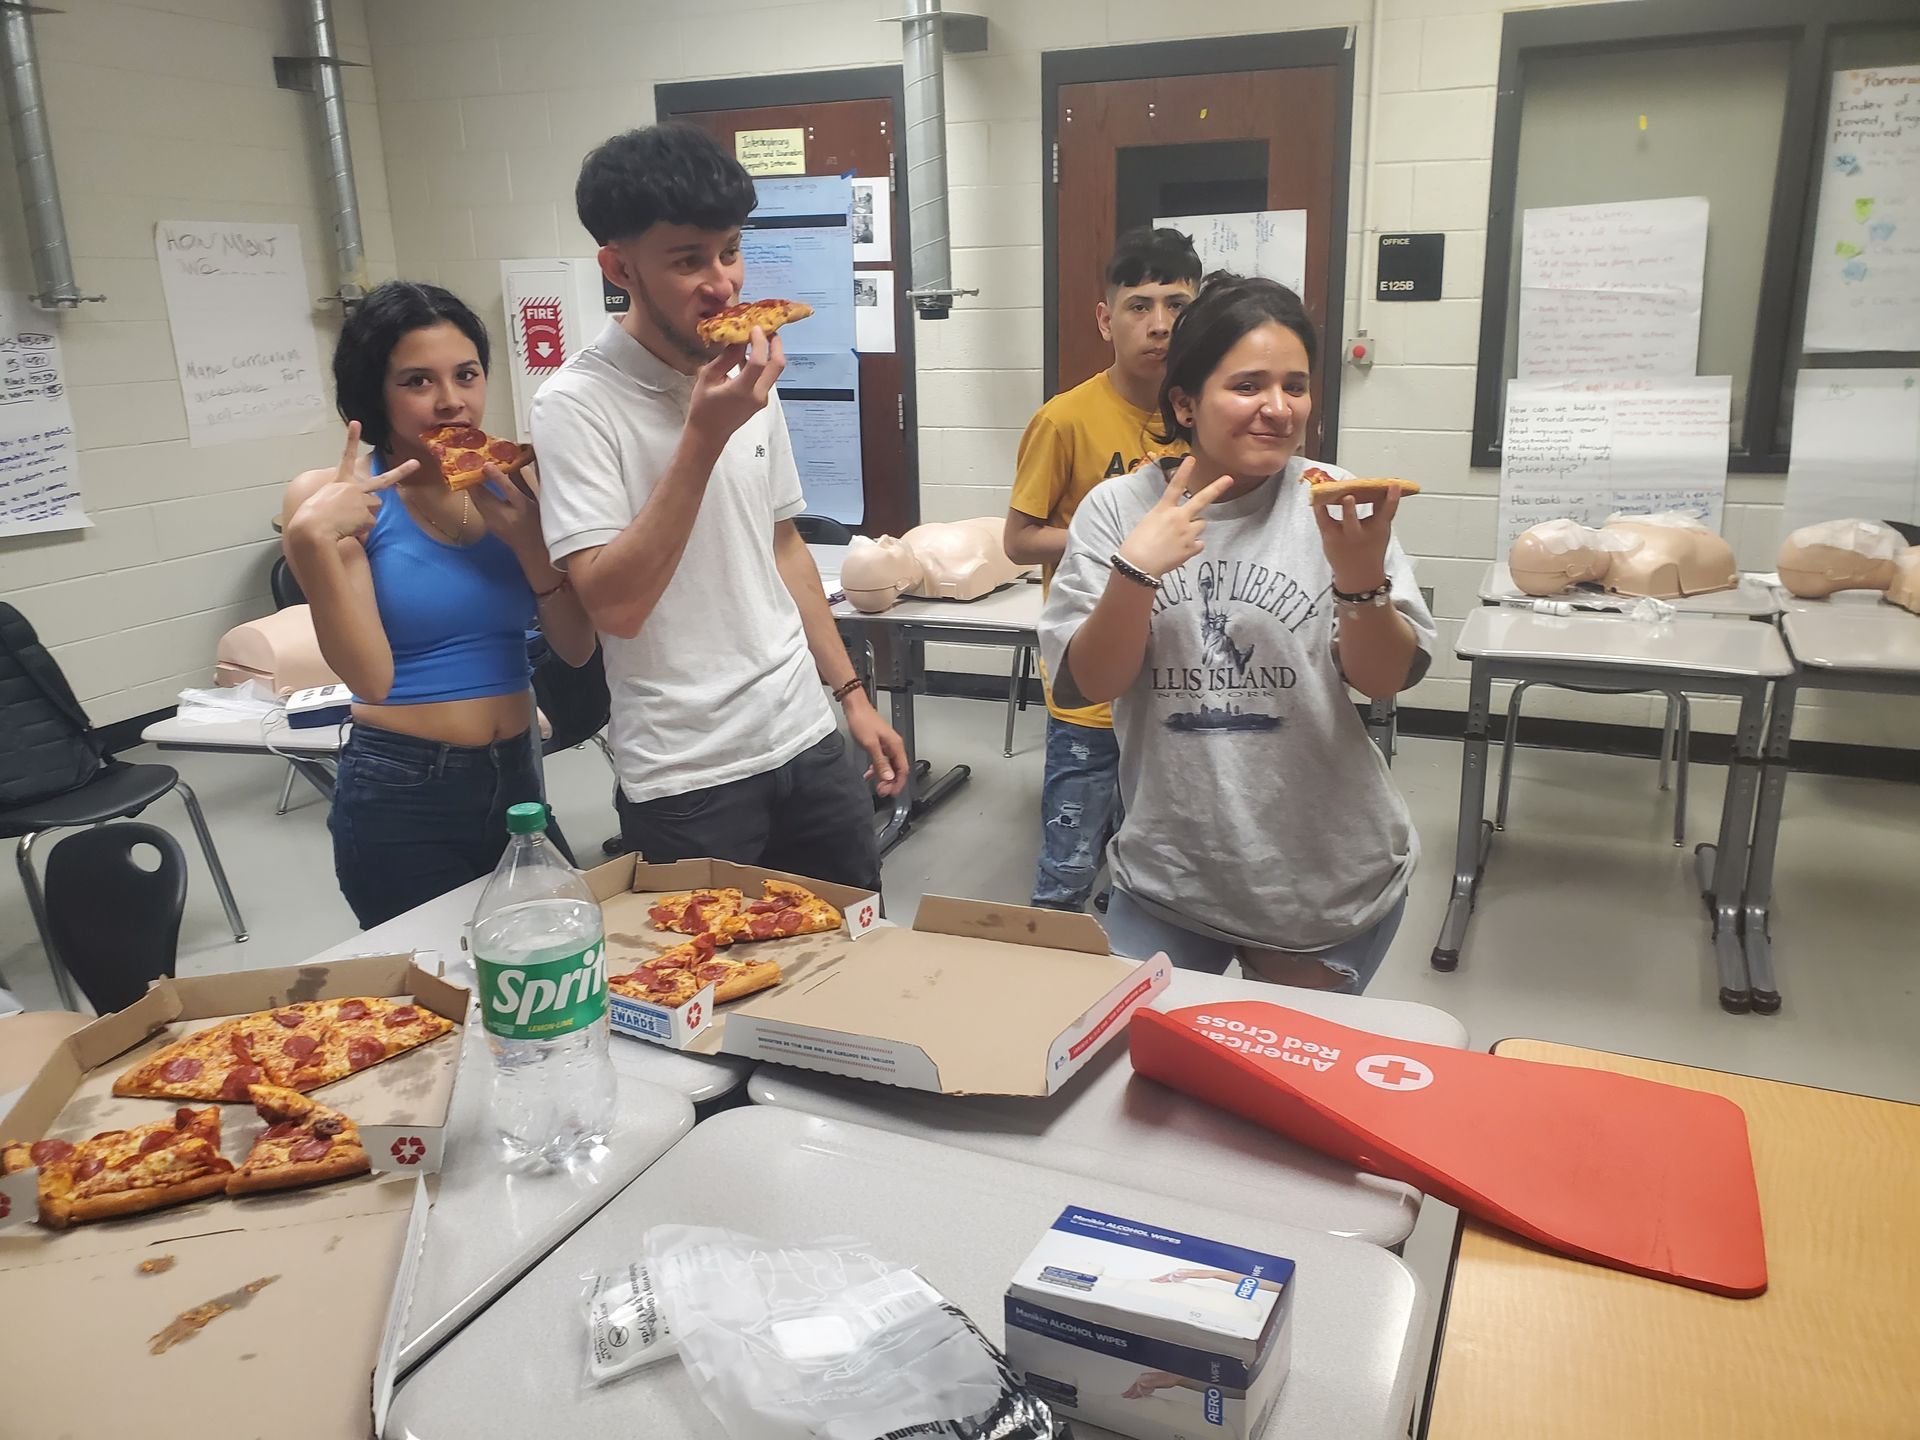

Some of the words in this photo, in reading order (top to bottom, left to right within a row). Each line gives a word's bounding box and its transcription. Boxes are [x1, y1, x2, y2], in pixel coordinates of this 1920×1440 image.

[1382, 238, 1411, 246] OFFICE
[1380, 280, 1415, 291] E125B
[605, 296, 624, 304] E127
[526, 308, 556, 320] FIRE
[1198, 560, 1228, 602] OF
[1229, 560, 1320, 634] LIBERTY
[1152, 667, 1202, 692] LLIS
[1208, 666, 1297, 691] ISLAND
[1157, 691, 1207, 699] NEW
[1215, 690, 1276, 699] YORK
[492, 942, 608, 1026] Sprit
[611, 1008, 655, 1031] EWARDS
[1196, 1015, 1278, 1044] Cross
[1282, 1036, 1342, 1061] Red
[1072, 1214, 1106, 1226] Manikin
[1106, 1222, 1149, 1237] ALCOHOL
[1150, 1232, 1181, 1245] WIPES
[1238, 1277, 1258, 1299] AERO
[1251, 1264, 1265, 1277] WIPE
[1015, 1306, 1049, 1325] Manikin
[1049, 1319, 1094, 1338] ALCOHOL
[1095, 1332, 1128, 1348] WIPES
[1211, 1360, 1221, 1383] WIPE
[1207, 1388, 1220, 1423] AERO
